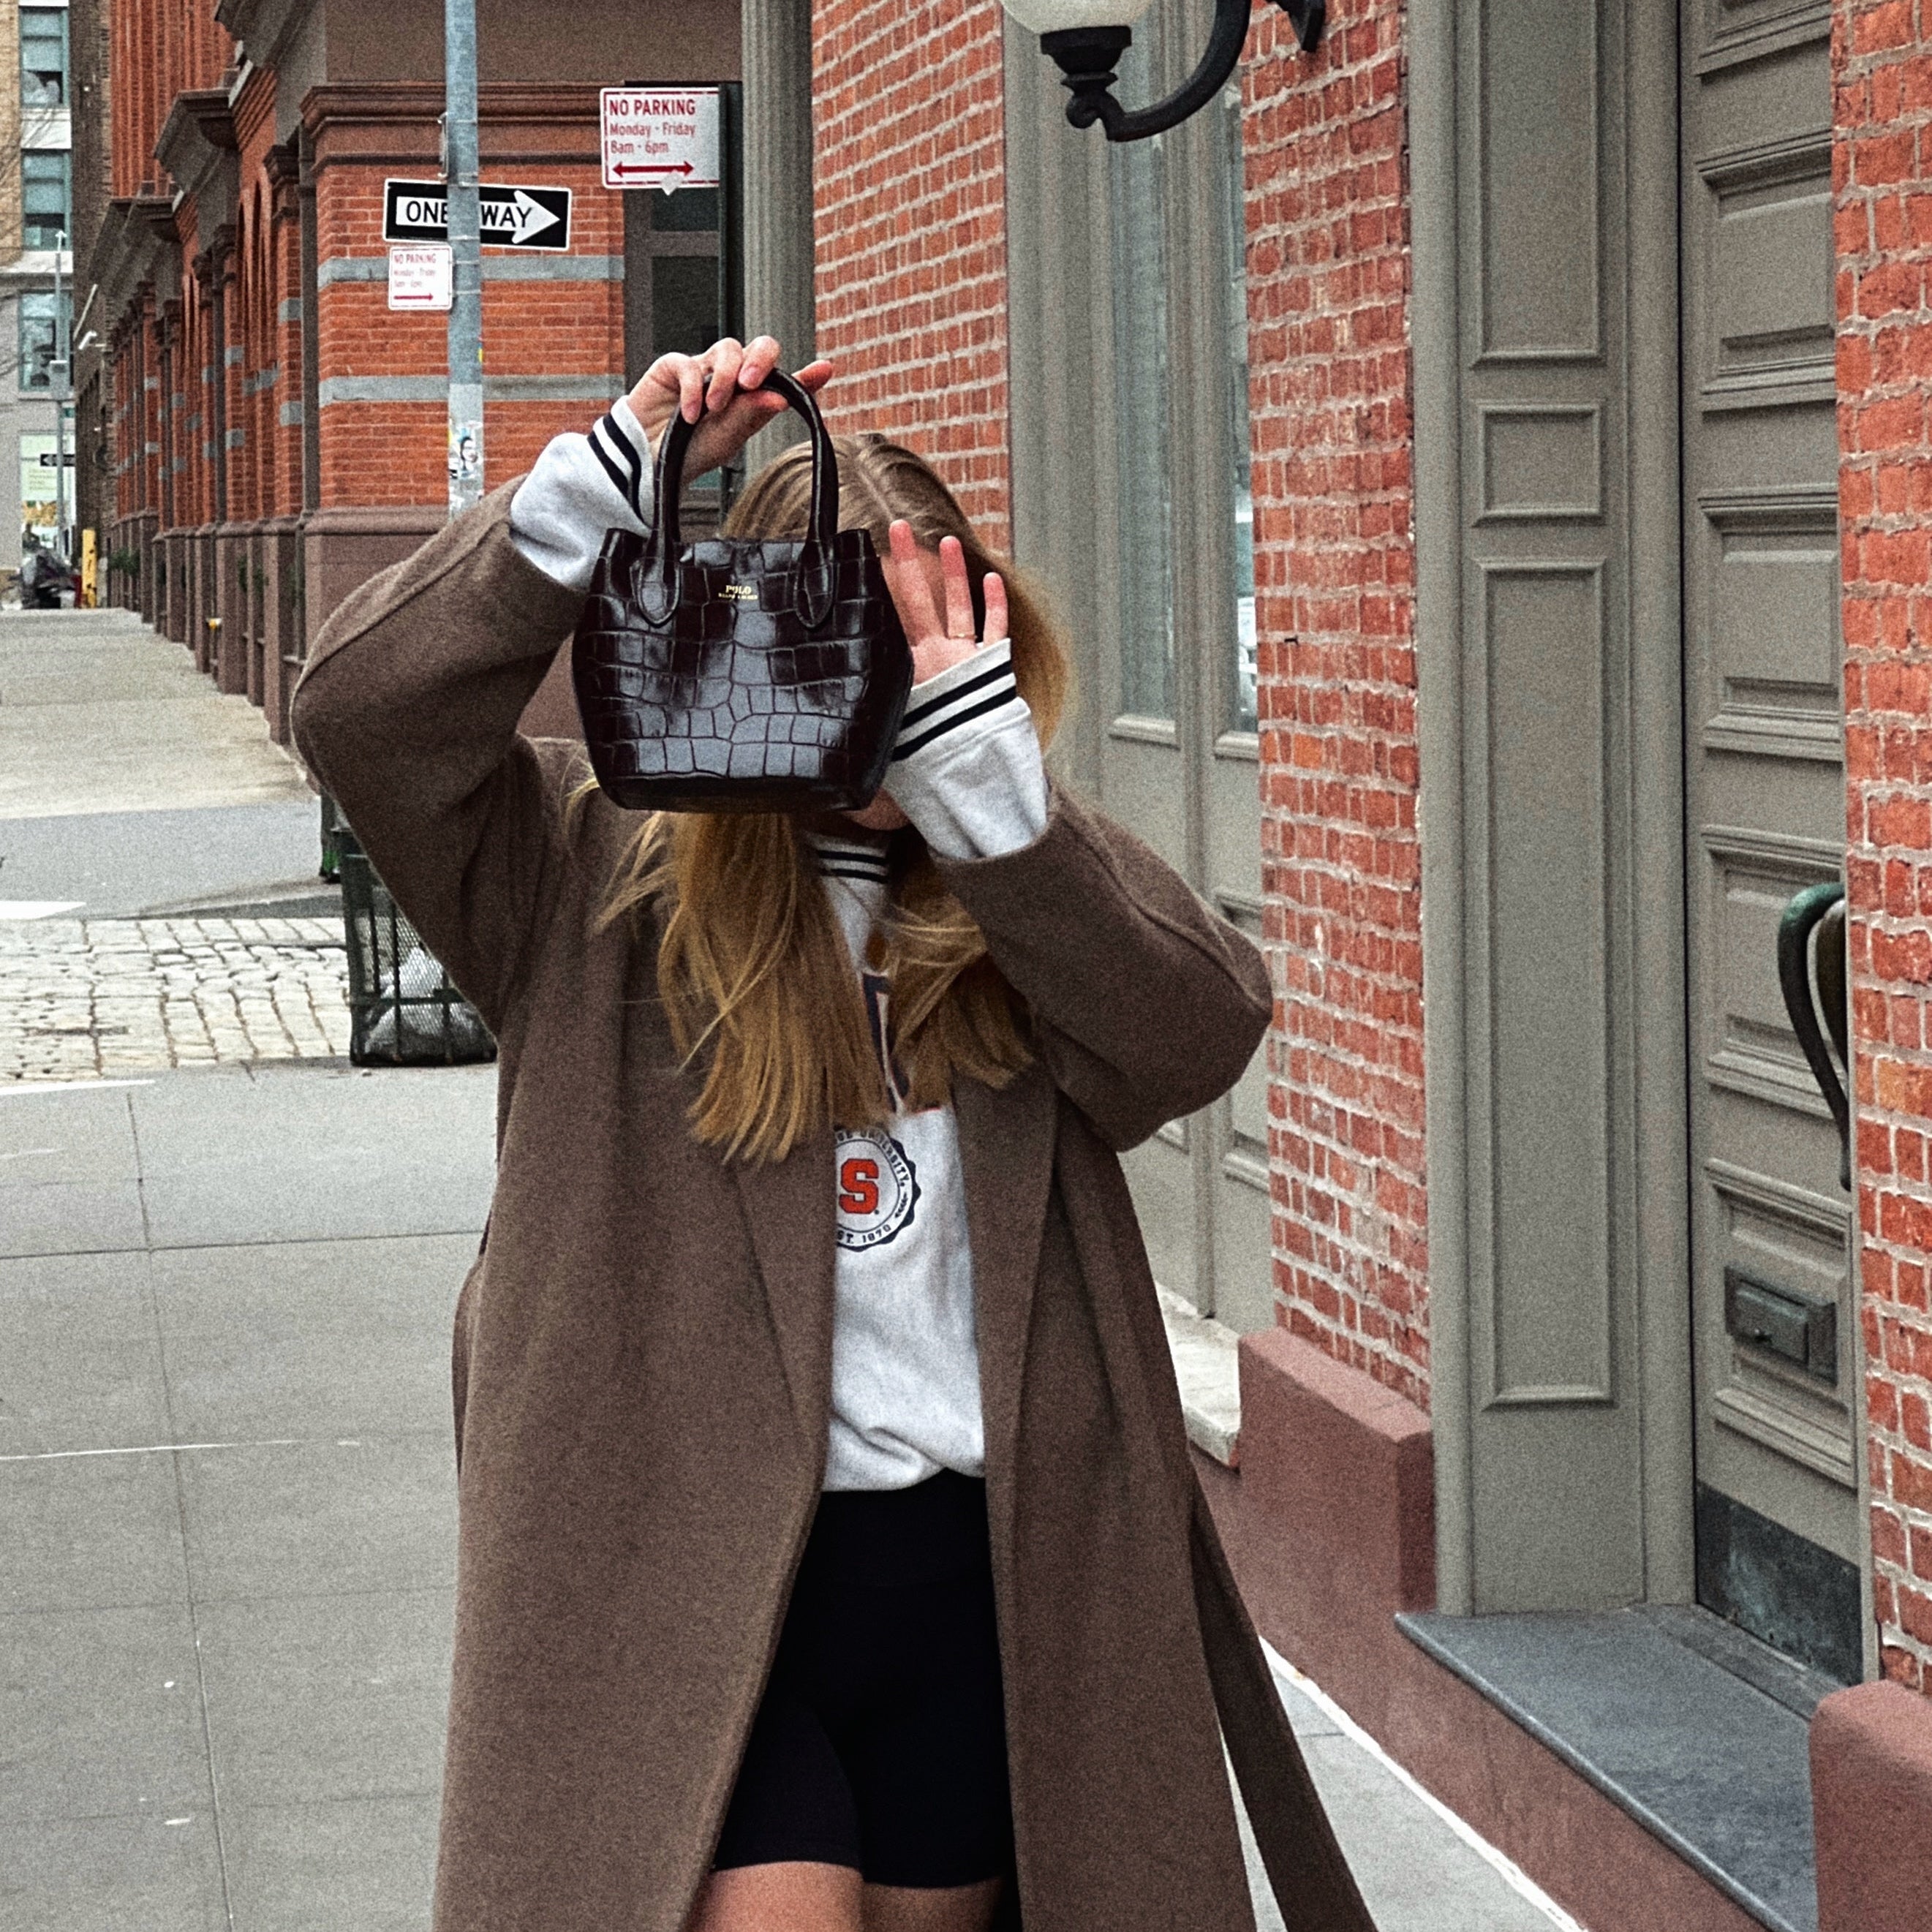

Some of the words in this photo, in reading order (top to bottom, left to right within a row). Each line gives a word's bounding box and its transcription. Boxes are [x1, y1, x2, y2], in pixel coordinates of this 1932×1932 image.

[610, 99, 629, 116] NO
[634, 99, 695, 116] PARKING
[610, 123, 651, 138] Monday
[663, 122, 695, 138] Friday
[611, 140, 634, 154] 8am
[645, 140, 669, 154] 6pm
[406, 201, 448, 224] ONE
[481, 204, 532, 228] WAY
[725, 585, 752, 595] POLO
[840, 1158, 879, 1214] S
[862, 1224, 892, 1243] 1870
